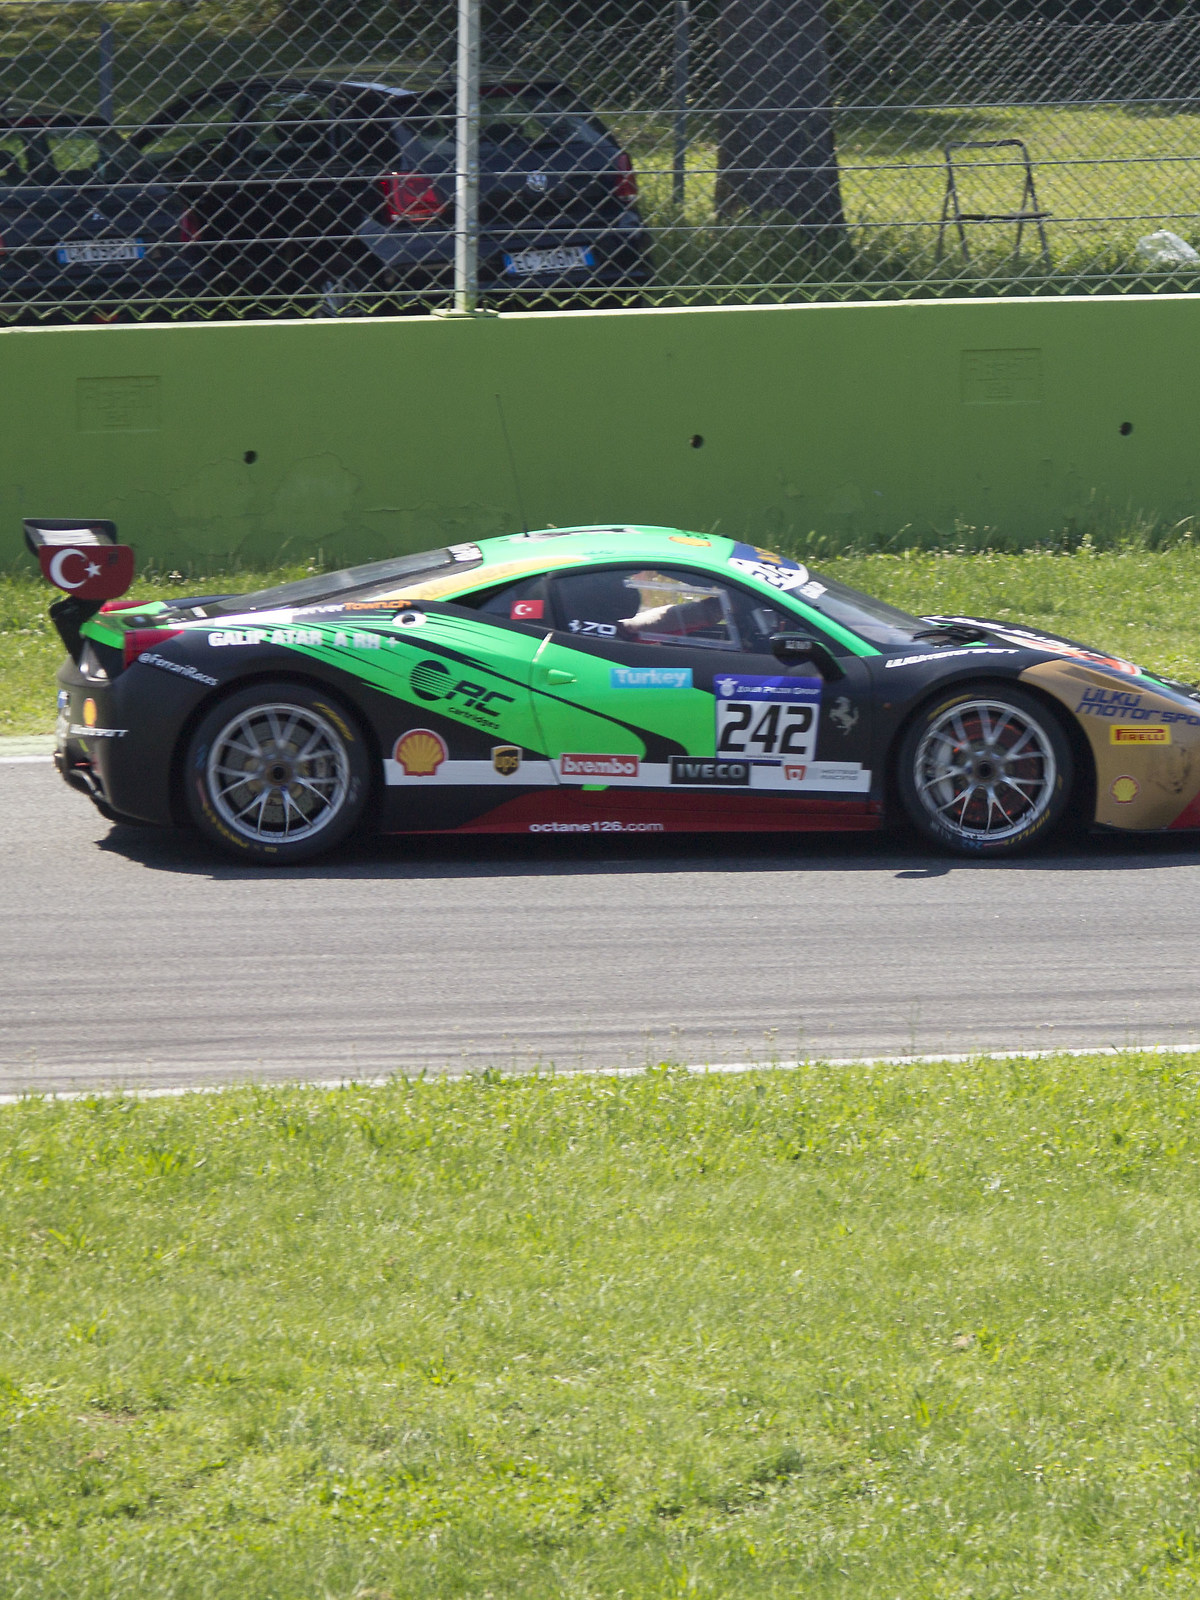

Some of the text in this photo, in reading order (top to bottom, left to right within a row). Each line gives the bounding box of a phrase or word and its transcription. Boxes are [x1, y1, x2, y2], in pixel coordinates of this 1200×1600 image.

[208, 631, 266, 646] GALIP
[271, 629, 322, 646] ATAR
[615, 668, 686, 687] Turkey
[717, 703, 813, 755] 242
[1115, 728, 1165, 741] PIRELLI
[563, 757, 636, 775] brembo
[676, 763, 746, 779] IVECO
[529, 820, 664, 833] octane126.com
